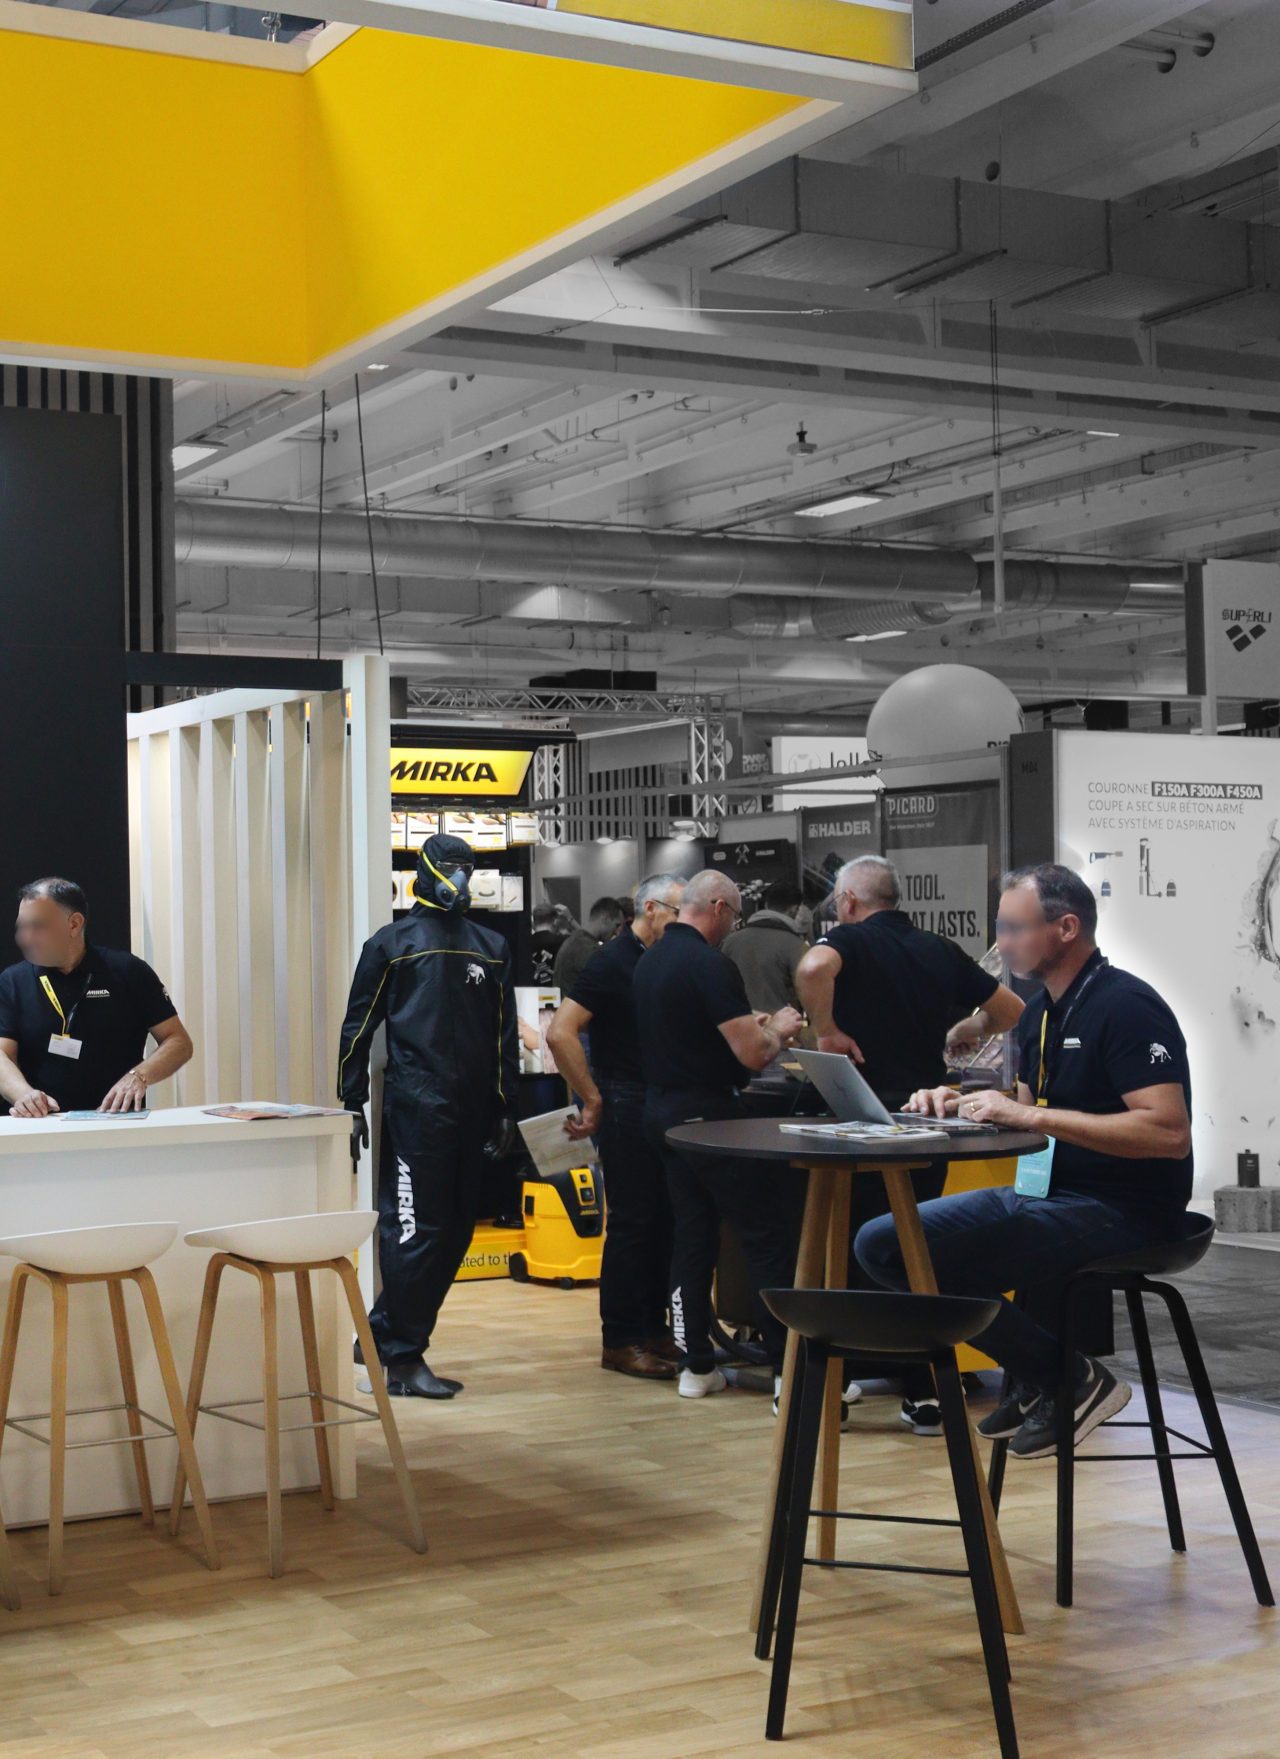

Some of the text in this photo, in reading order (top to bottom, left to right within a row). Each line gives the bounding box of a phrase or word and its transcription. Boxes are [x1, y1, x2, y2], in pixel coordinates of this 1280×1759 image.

[391, 761, 498, 782] MIRKA
[1088, 782, 1261, 798] COURONNE F150A F300A F450A
[888, 796, 935, 815] PICARD
[1088, 800, 1123, 811] COUPE
[1136, 801, 1154, 812] SEC
[1157, 802, 1177, 813] SUR
[1179, 800, 1213, 814] BÉTON
[1215, 801, 1245, 815] ARMÉ
[818, 820, 871, 837] HALDER
[1088, 815, 1236, 831] AVEC SYSTÈME D'ASPIRATION
[905, 874, 945, 900] TOOL.
[930, 910, 980, 937] LASTS.
[397, 1155, 417, 1245] MIRKA
[488, 1255, 501, 1266] to
[671, 1286, 688, 1353] MIRKA
